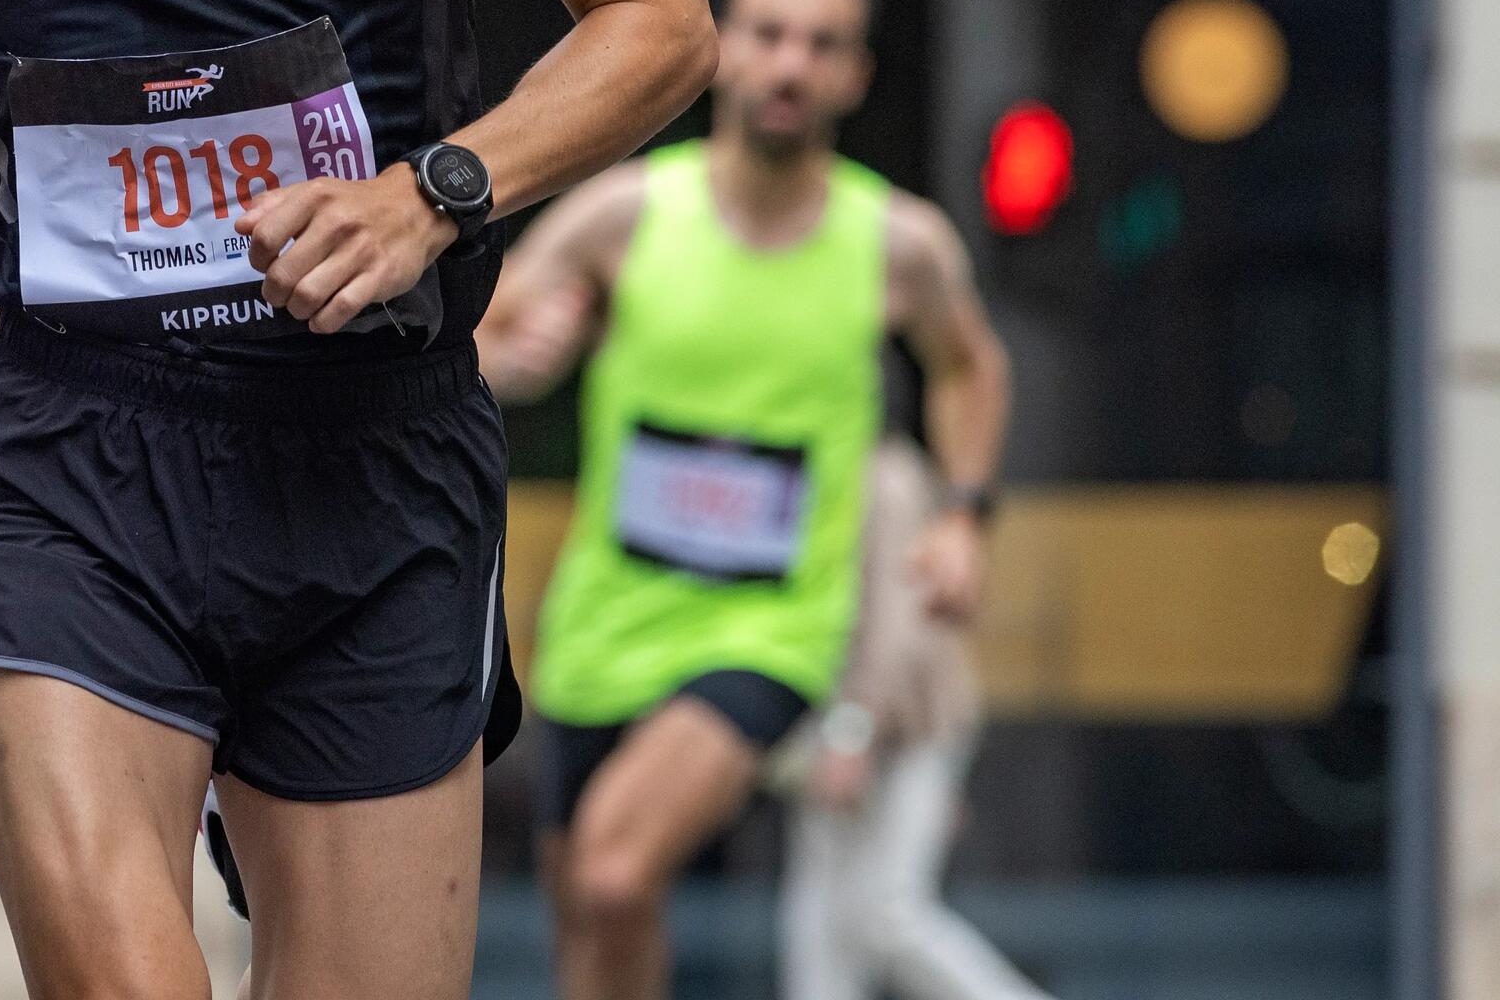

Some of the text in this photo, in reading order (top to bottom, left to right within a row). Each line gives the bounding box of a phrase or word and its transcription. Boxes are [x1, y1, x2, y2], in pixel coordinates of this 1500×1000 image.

[148, 88, 191, 114] RUN
[303, 103, 351, 149] 2H
[312, 148, 358, 180] 30
[108, 134, 281, 232] 1018
[128, 242, 207, 272] THOMAS
[161, 299, 274, 330] KIPRUN
